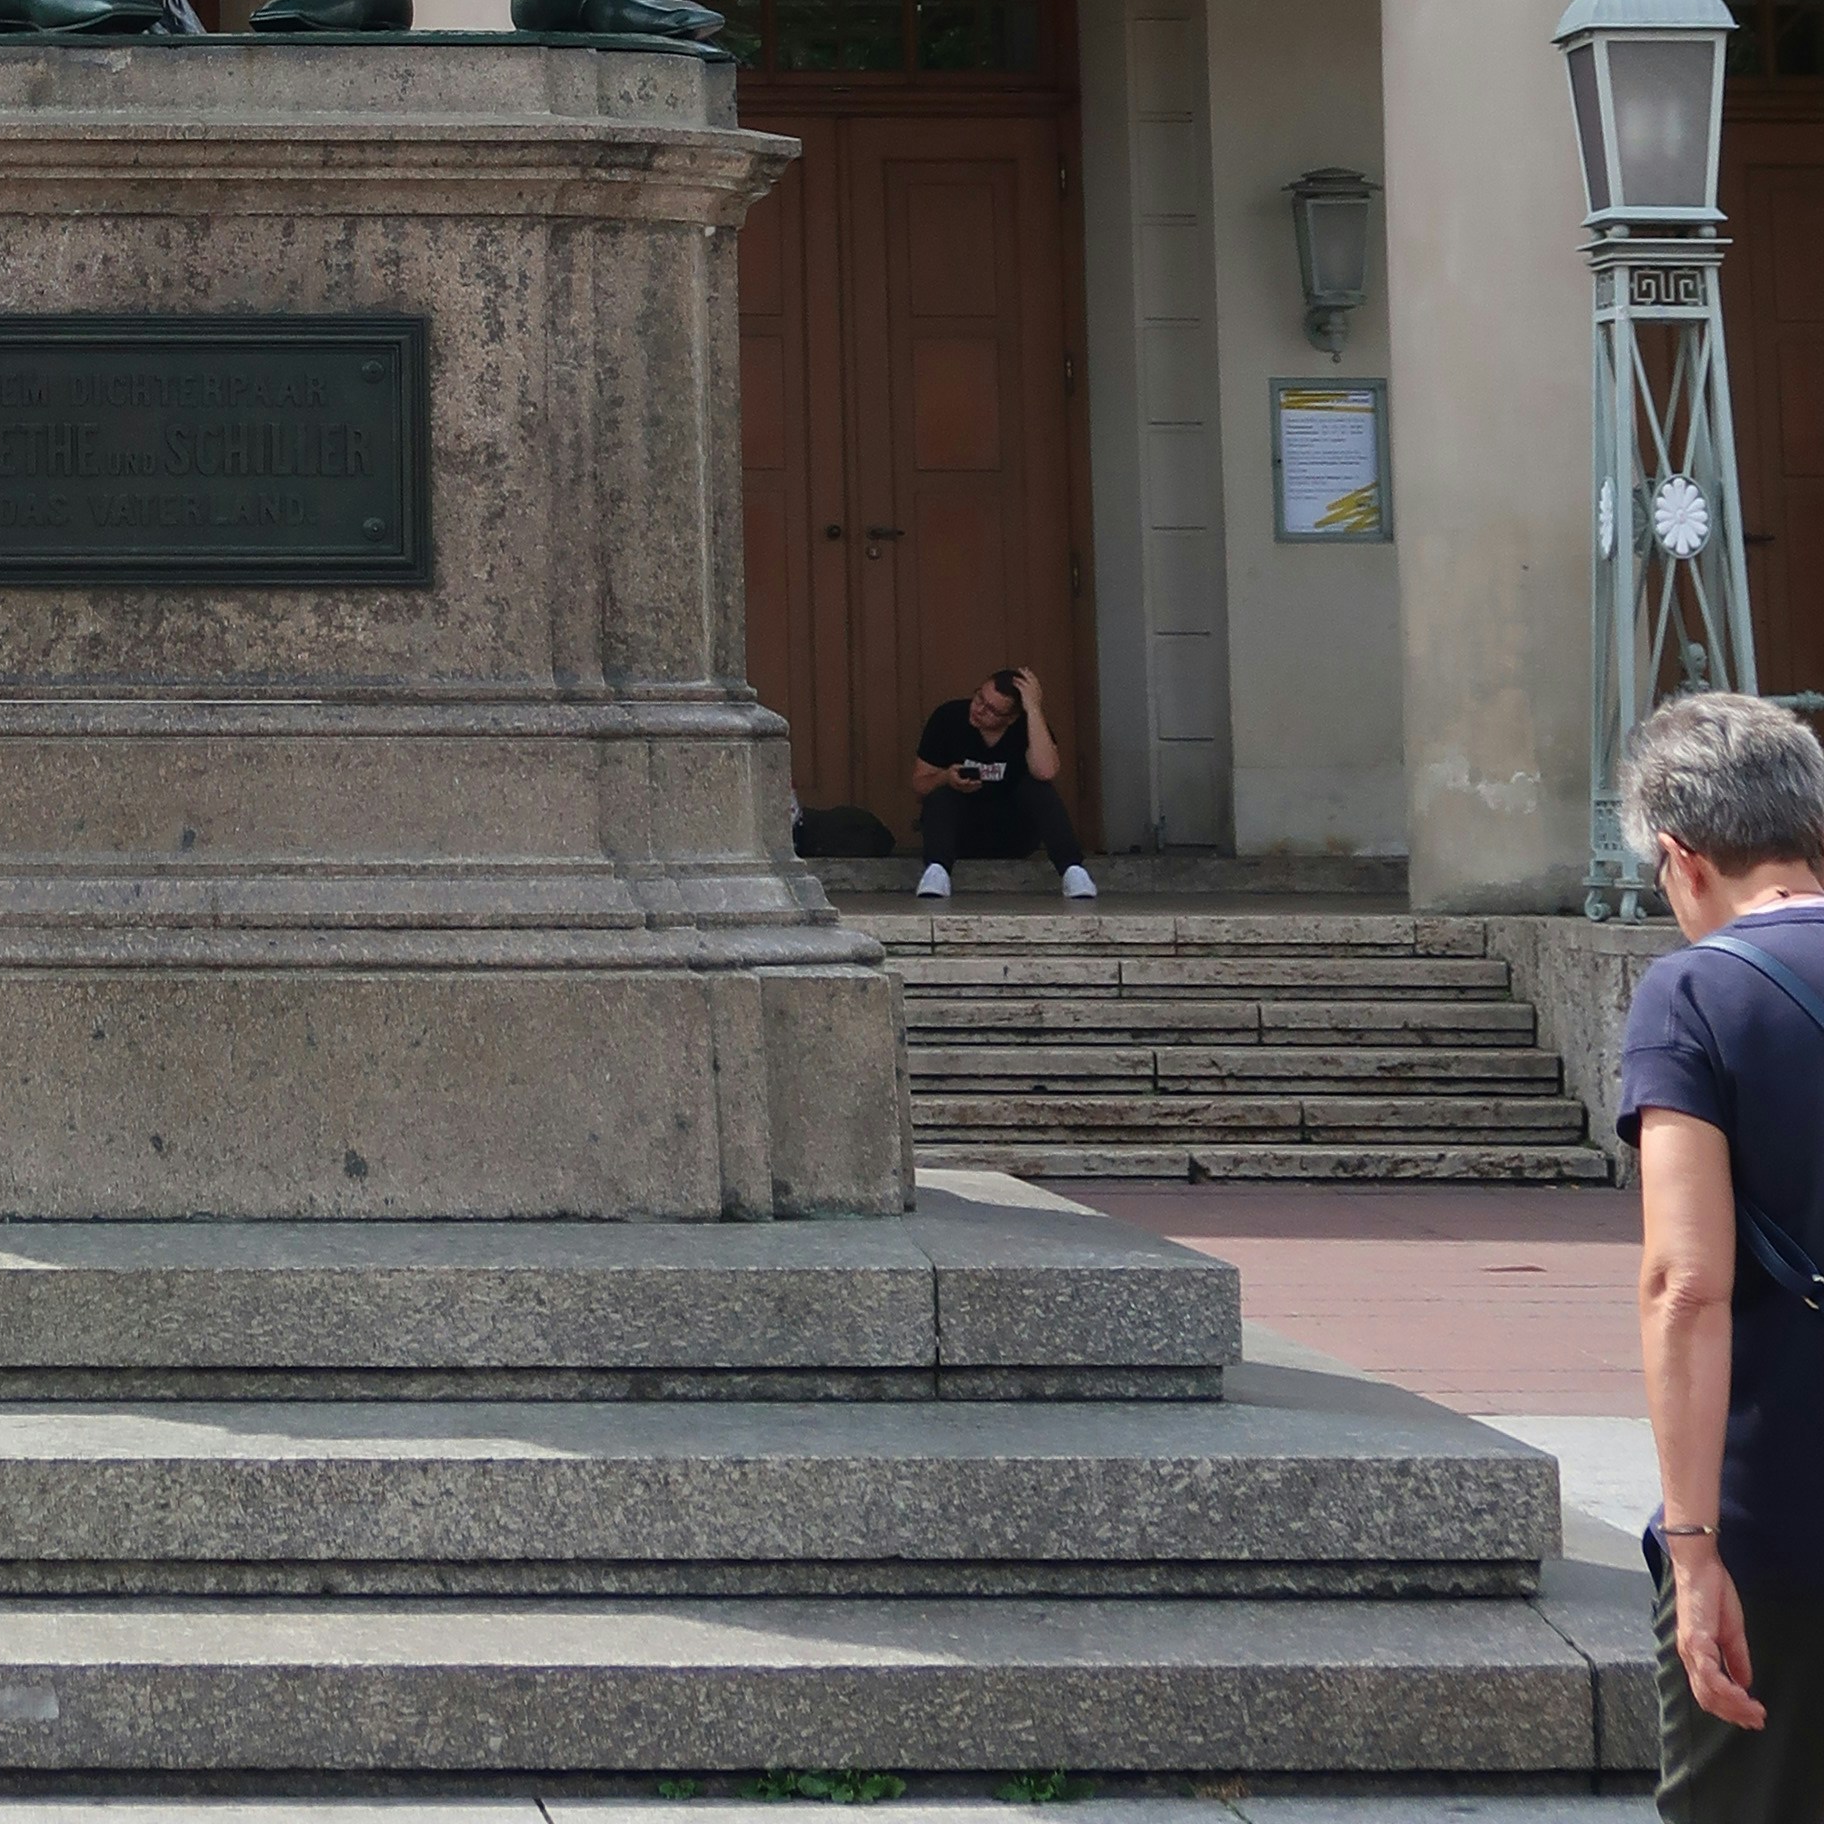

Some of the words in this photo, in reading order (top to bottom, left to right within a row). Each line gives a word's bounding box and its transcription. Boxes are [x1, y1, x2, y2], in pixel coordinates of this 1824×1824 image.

[71, 372, 329, 409] DICHTERPAAR
[163, 422, 375, 477] SCHILLER
[0, 493, 73, 528] DAS
[86, 493, 318, 528] VATERLAND.
